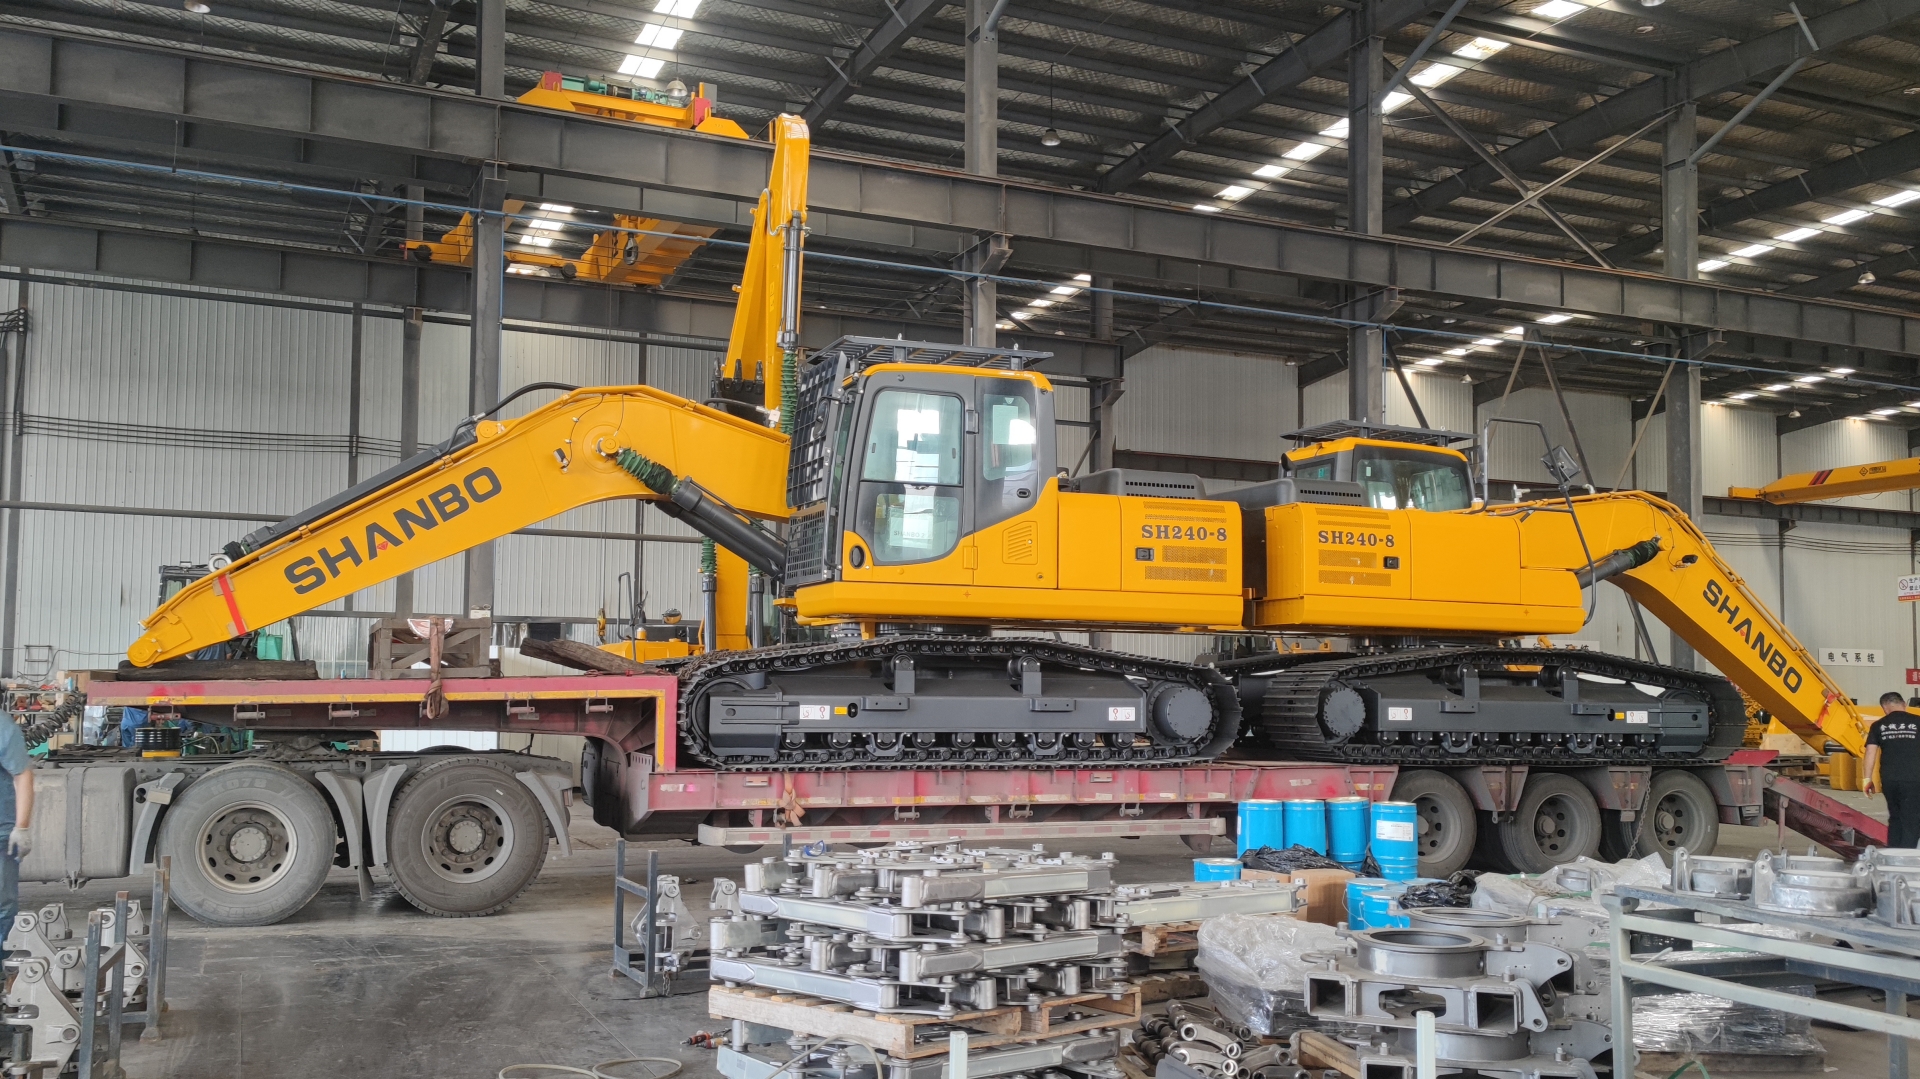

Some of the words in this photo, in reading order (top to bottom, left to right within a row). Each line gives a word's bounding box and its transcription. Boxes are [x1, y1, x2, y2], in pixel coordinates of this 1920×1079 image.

[284, 467, 502, 595] SHANBO
[1141, 524, 1227, 542] SH240-8
[1318, 530, 1395, 548] SH240-8
[1703, 579, 1803, 694] SHANBO
[1827, 652, 1875, 663] 电气系统
